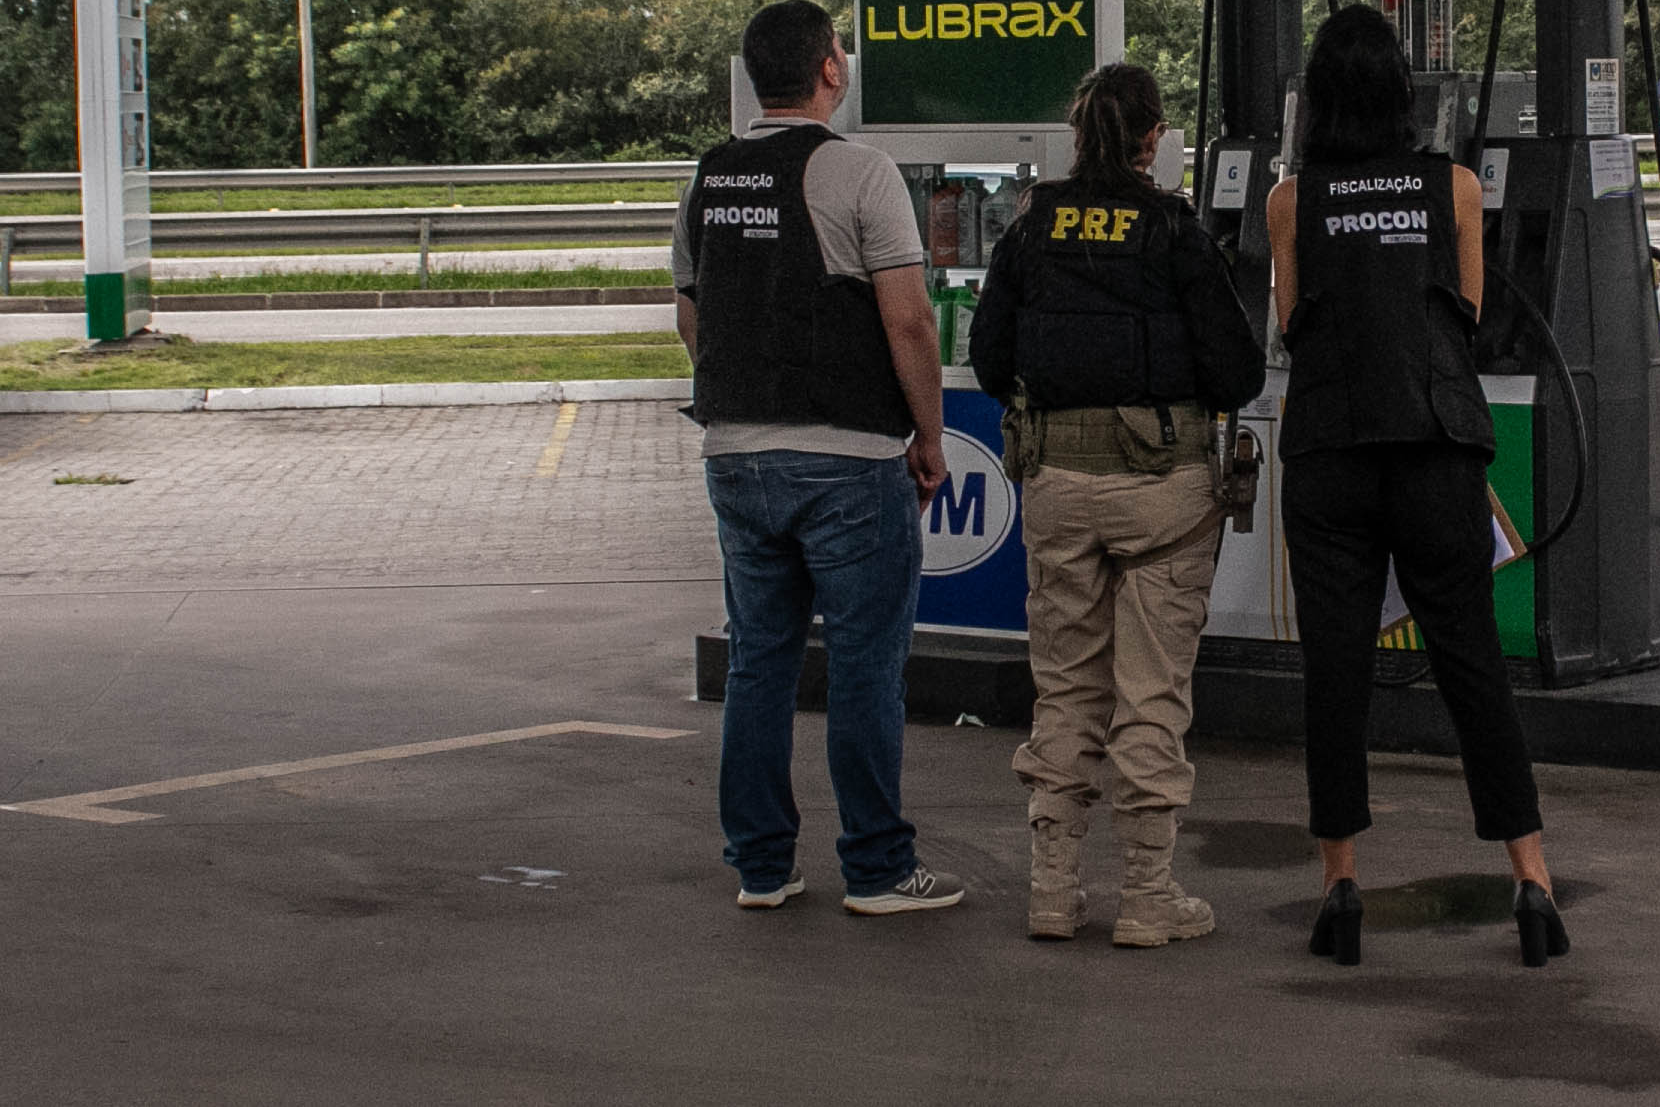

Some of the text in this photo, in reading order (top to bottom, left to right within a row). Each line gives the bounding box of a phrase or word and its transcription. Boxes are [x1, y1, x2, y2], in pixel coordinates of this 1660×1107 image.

[867, 0, 1088, 41] LUBRAX
[703, 173, 774, 190] FISCALIZAÇÃO
[1329, 175, 1423, 196] FISCALIZAÇÃO
[703, 207, 779, 226] PROCON
[1051, 207, 1139, 242] PRF
[1325, 210, 1428, 236] PROCON
